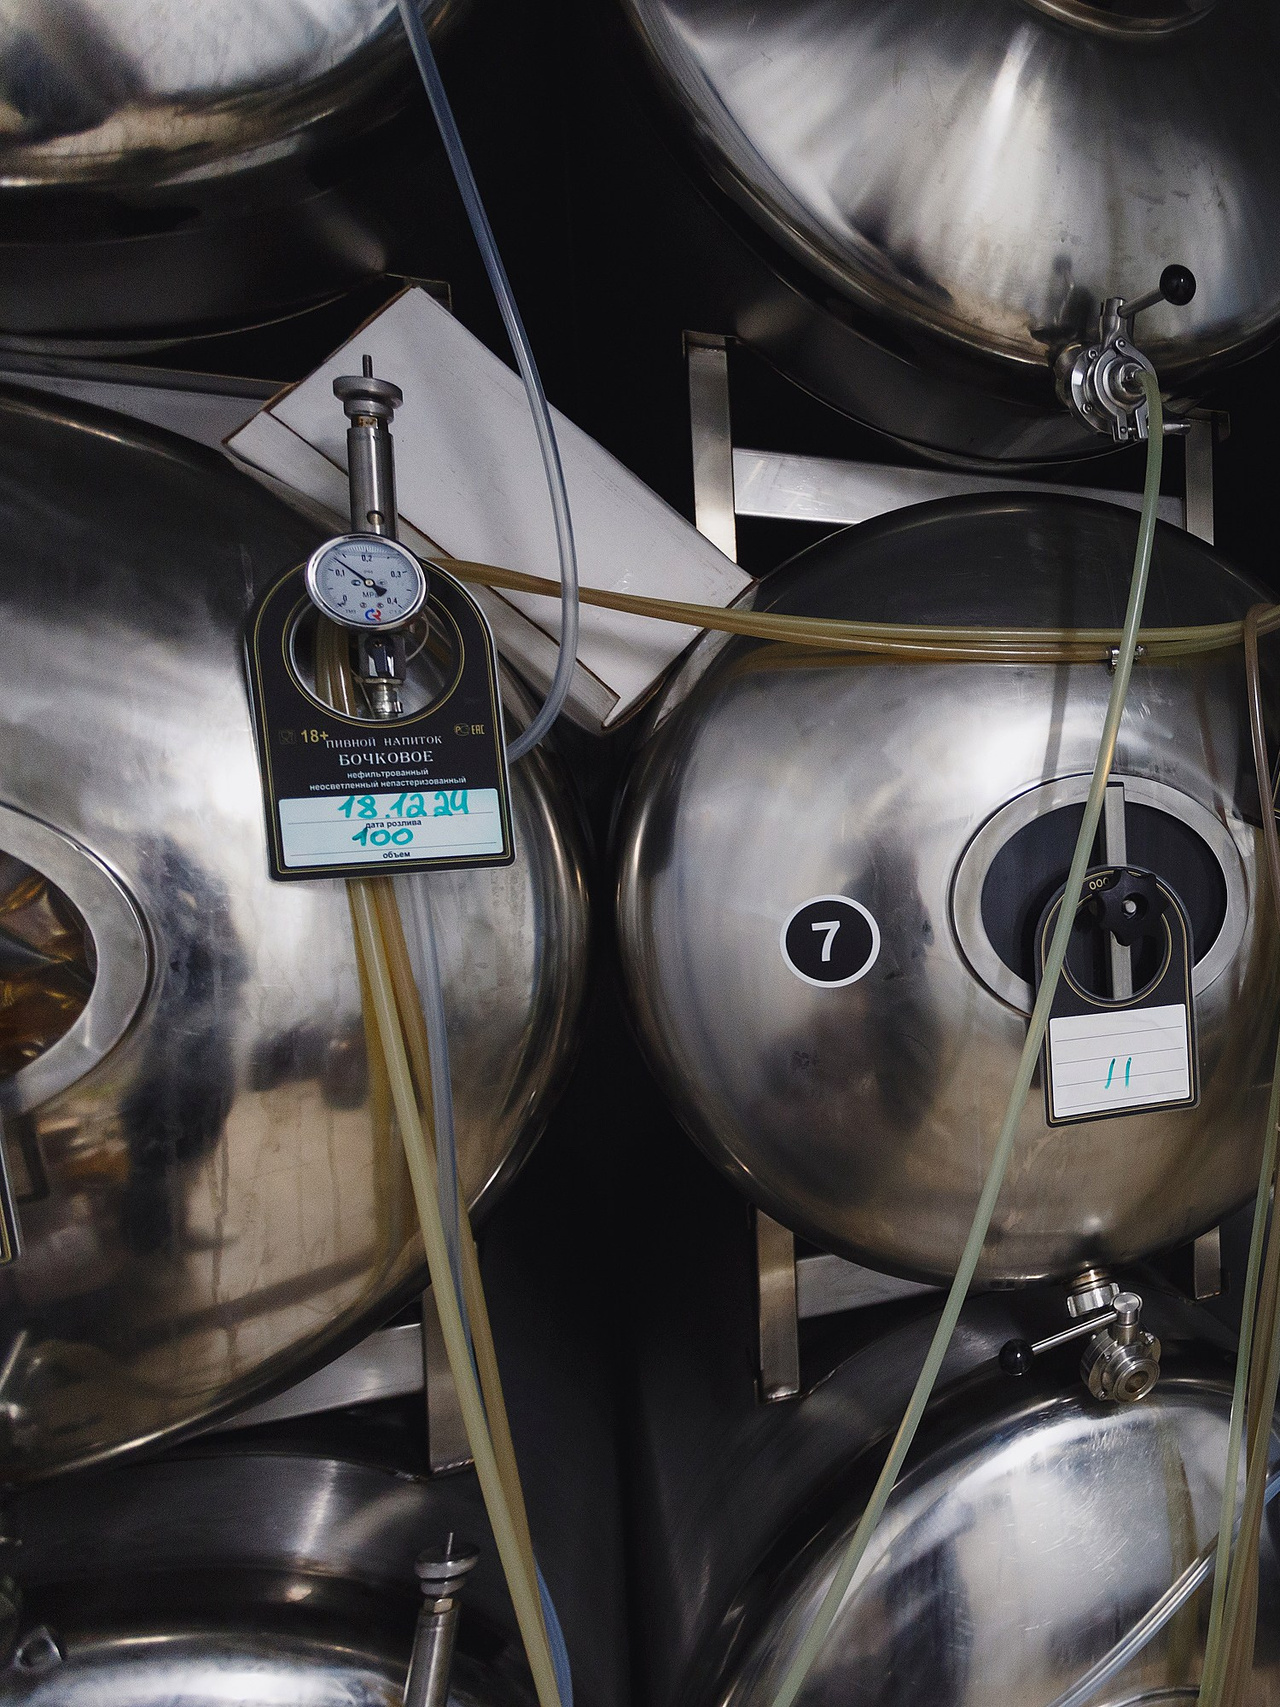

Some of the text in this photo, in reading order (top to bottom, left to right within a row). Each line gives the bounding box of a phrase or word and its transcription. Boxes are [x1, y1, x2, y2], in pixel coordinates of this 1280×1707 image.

[301, 729, 329, 744] 18+
[326, 735, 442, 749] ПИВНОЙ НАПИТОК
[339, 750, 433, 766] БОЧКОВОЕ
[347, 768, 429, 779] нефильтрованный
[309, 776, 467, 791] неосветленный непастеризованный
[352, 827, 414, 847] 100
[811, 920, 841, 962] 7
